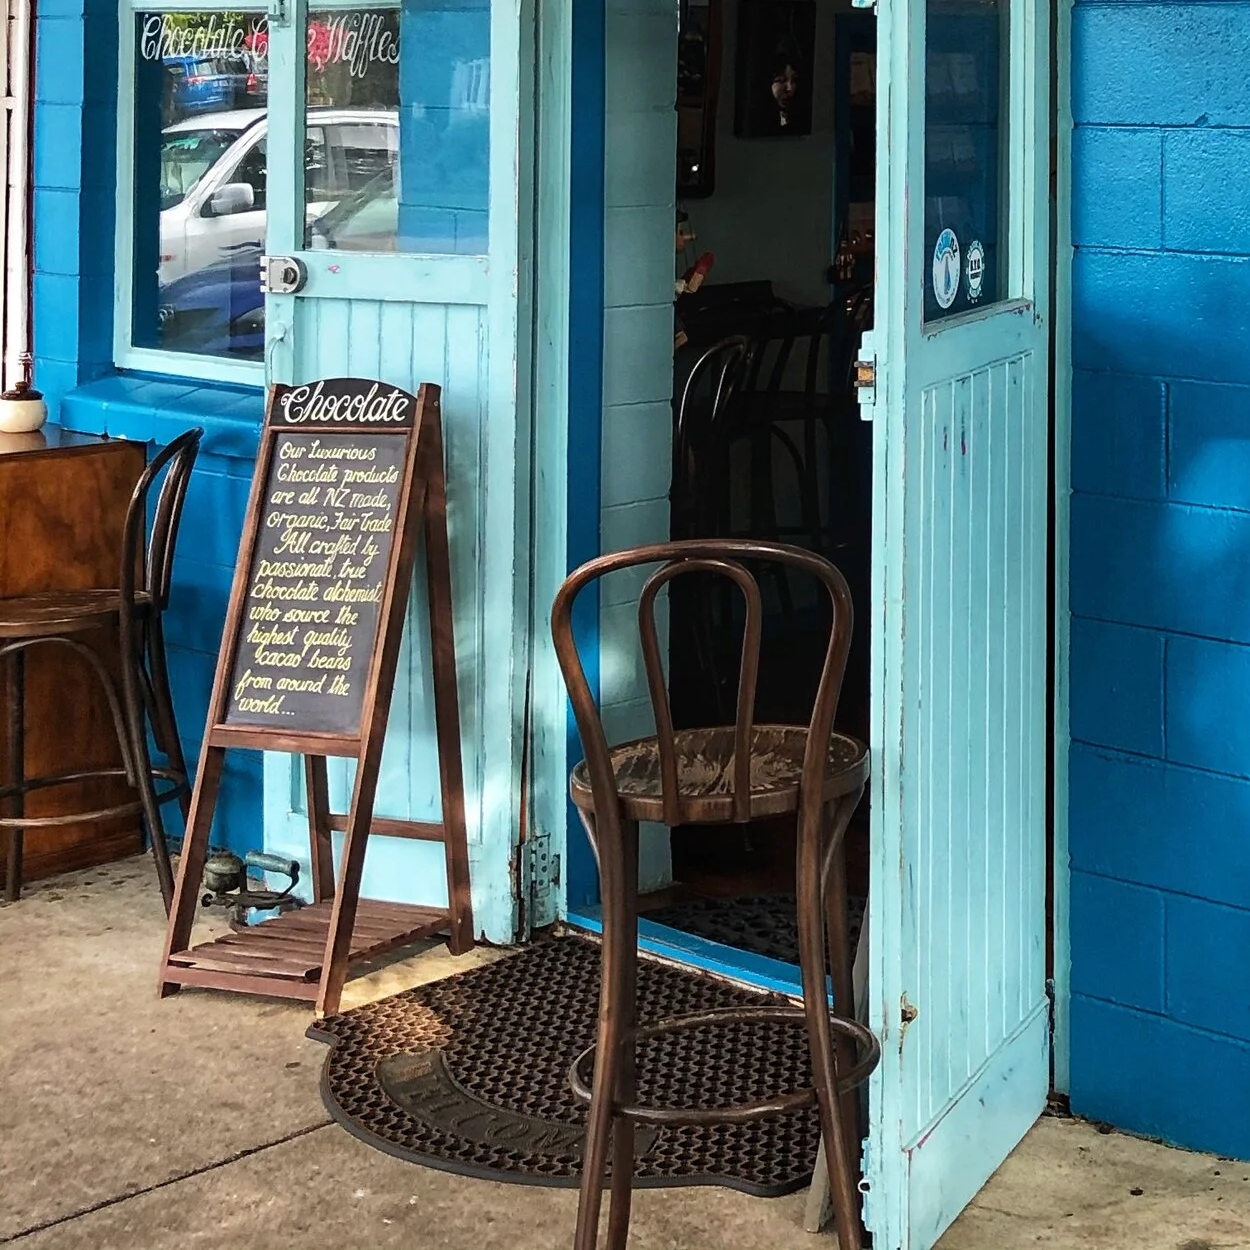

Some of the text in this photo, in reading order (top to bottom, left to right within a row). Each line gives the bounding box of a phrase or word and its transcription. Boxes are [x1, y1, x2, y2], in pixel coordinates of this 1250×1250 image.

[281, 381, 409, 423] Chocolate
[279, 439, 377, 461] Our Luxurious
[277, 463, 400, 490] Chocolate products
[271, 486, 392, 511] are all NZ made,
[330, 511, 360, 531] Fair
[360, 511, 393, 533] Trade
[273, 531, 380, 567] All crafted by
[337, 556, 367, 579] true
[249, 600, 359, 626] who source the
[246, 622, 353, 658] highest quality
[255, 648, 352, 671] cacao beans
[234, 668, 351, 701] from around the
[392, 1060, 612, 1152] WELCOM
